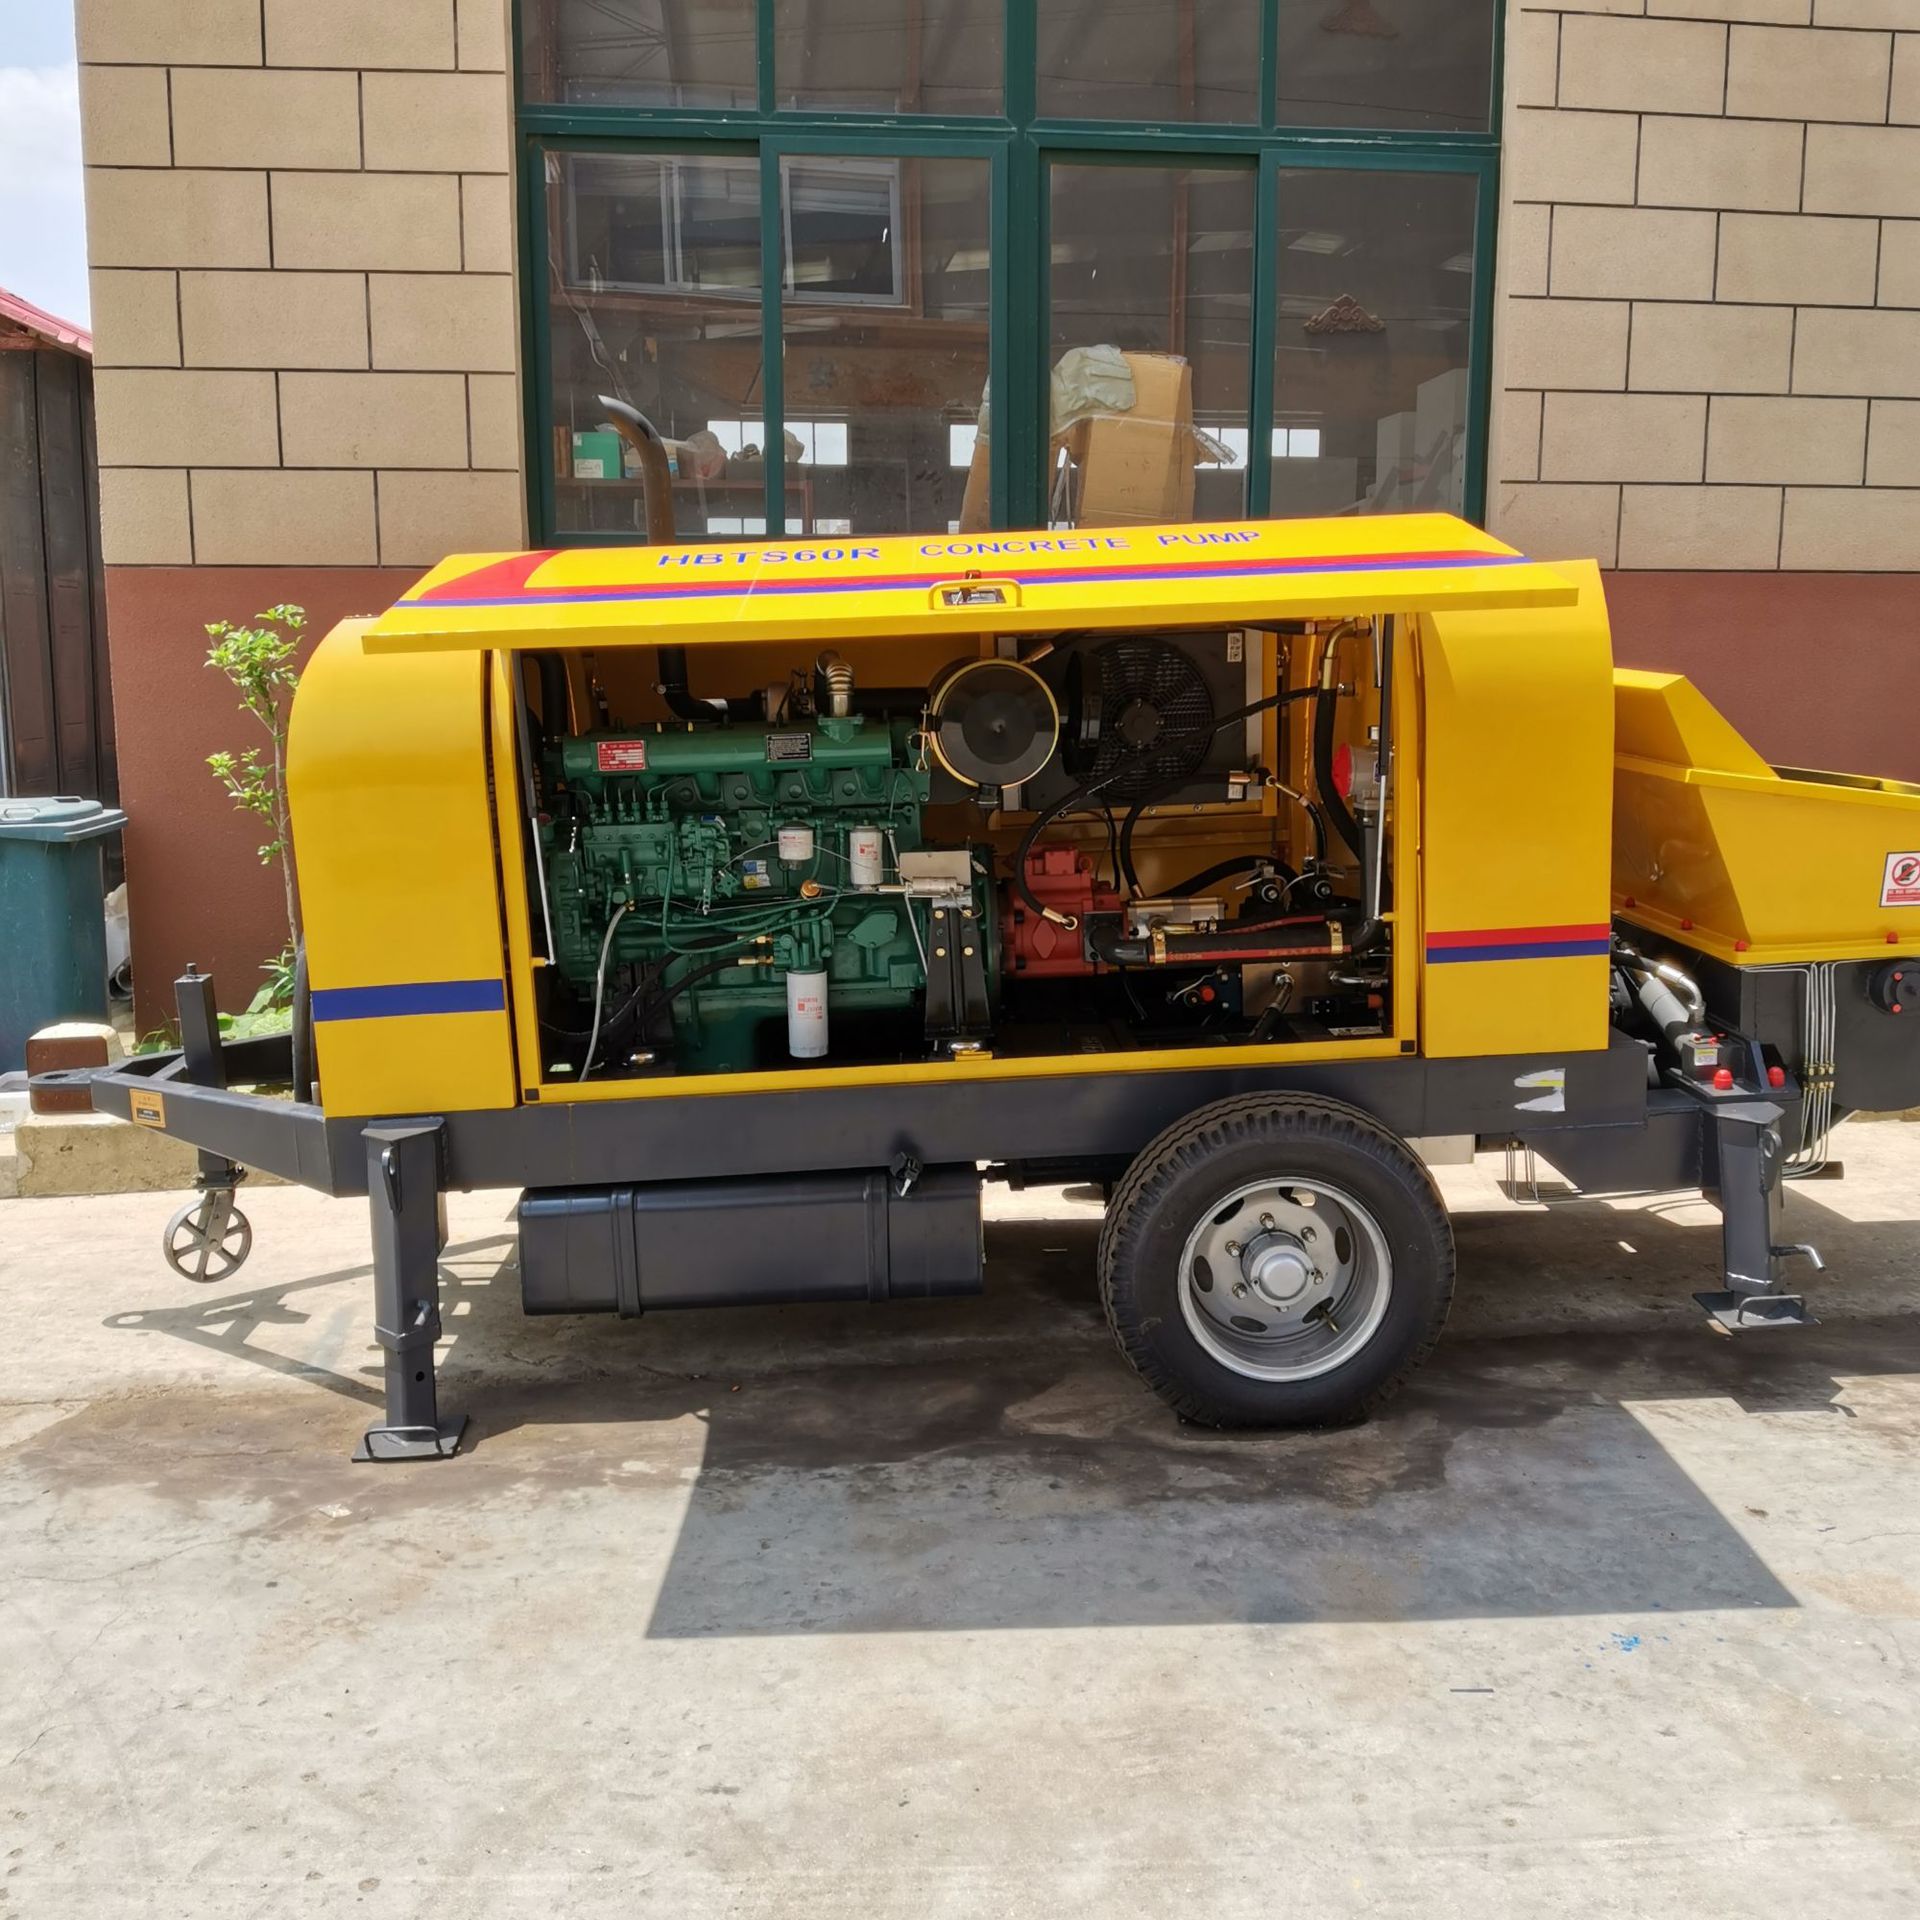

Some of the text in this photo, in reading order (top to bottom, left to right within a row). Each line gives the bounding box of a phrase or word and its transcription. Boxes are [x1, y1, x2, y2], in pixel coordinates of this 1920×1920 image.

[659, 530, 1261, 566] HBTS60R CONCRETE PUMP
